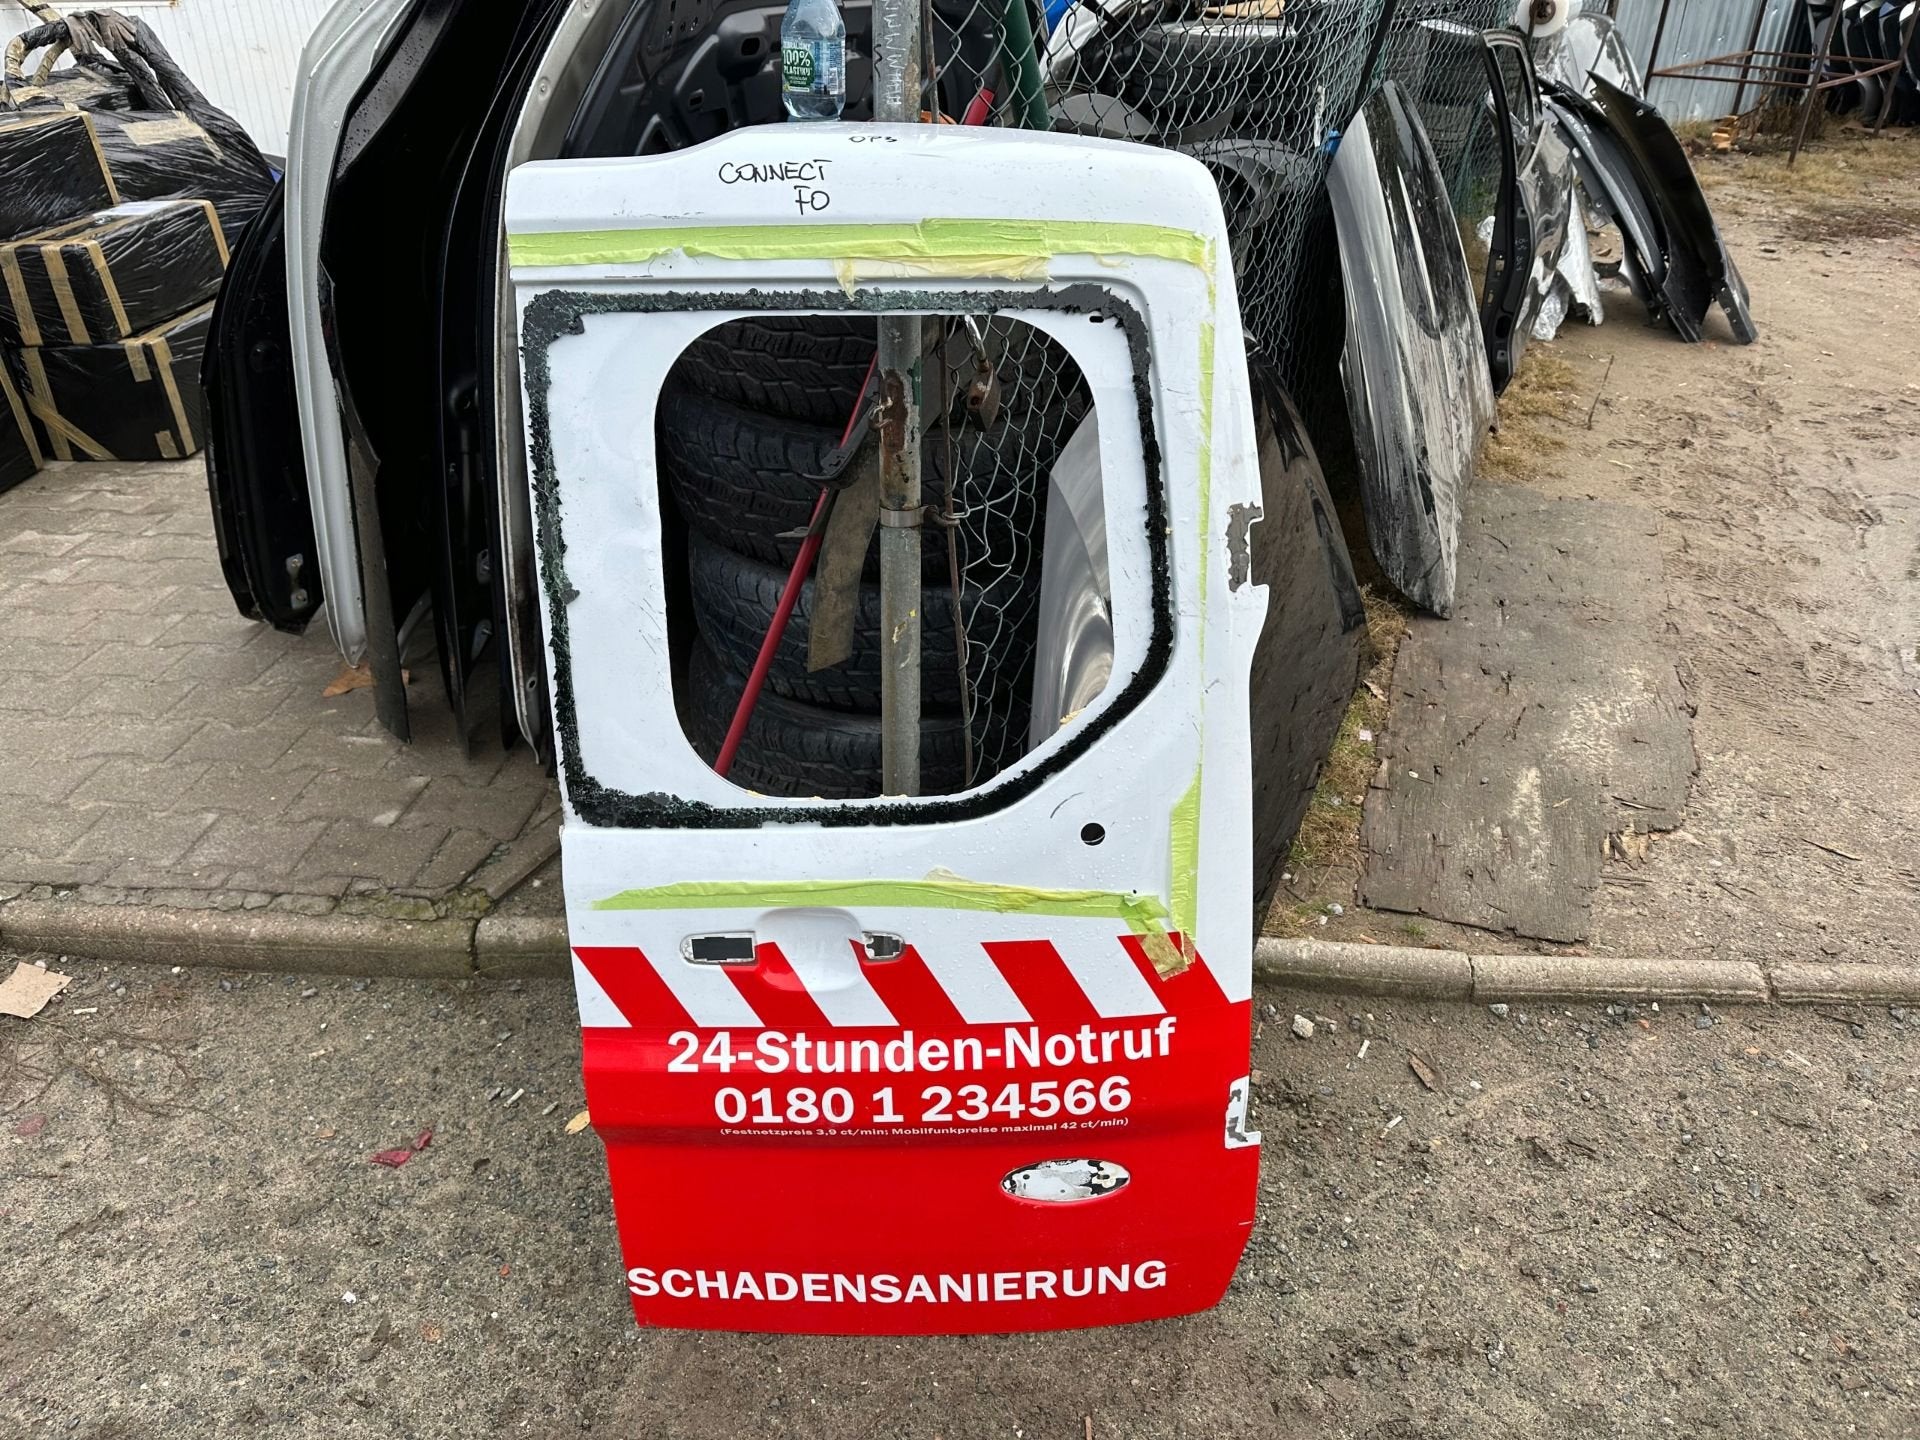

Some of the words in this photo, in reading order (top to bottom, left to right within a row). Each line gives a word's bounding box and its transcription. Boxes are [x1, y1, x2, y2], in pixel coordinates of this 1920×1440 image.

[783, 50, 811, 66] 100%
[718, 159, 833, 184] CONNECT
[667, 1016, 1177, 1073] 24-Stunden-Notruf
[714, 1087, 854, 1124] 0180
[872, 1086, 905, 1123] 1
[921, 1075, 1132, 1122] 234566
[720, 1128, 813, 1136] (Festnetzpreis
[816, 1128, 837, 1136] 3,9
[892, 1125, 998, 1136] Mobilfunkpreise
[1001, 1123, 1057, 1133] maximal
[1060, 1120, 1078, 1130] 42
[1080, 1117, 1129, 1130] ct/min)
[628, 1260, 1167, 1303] SCHADENSANIERUNG
